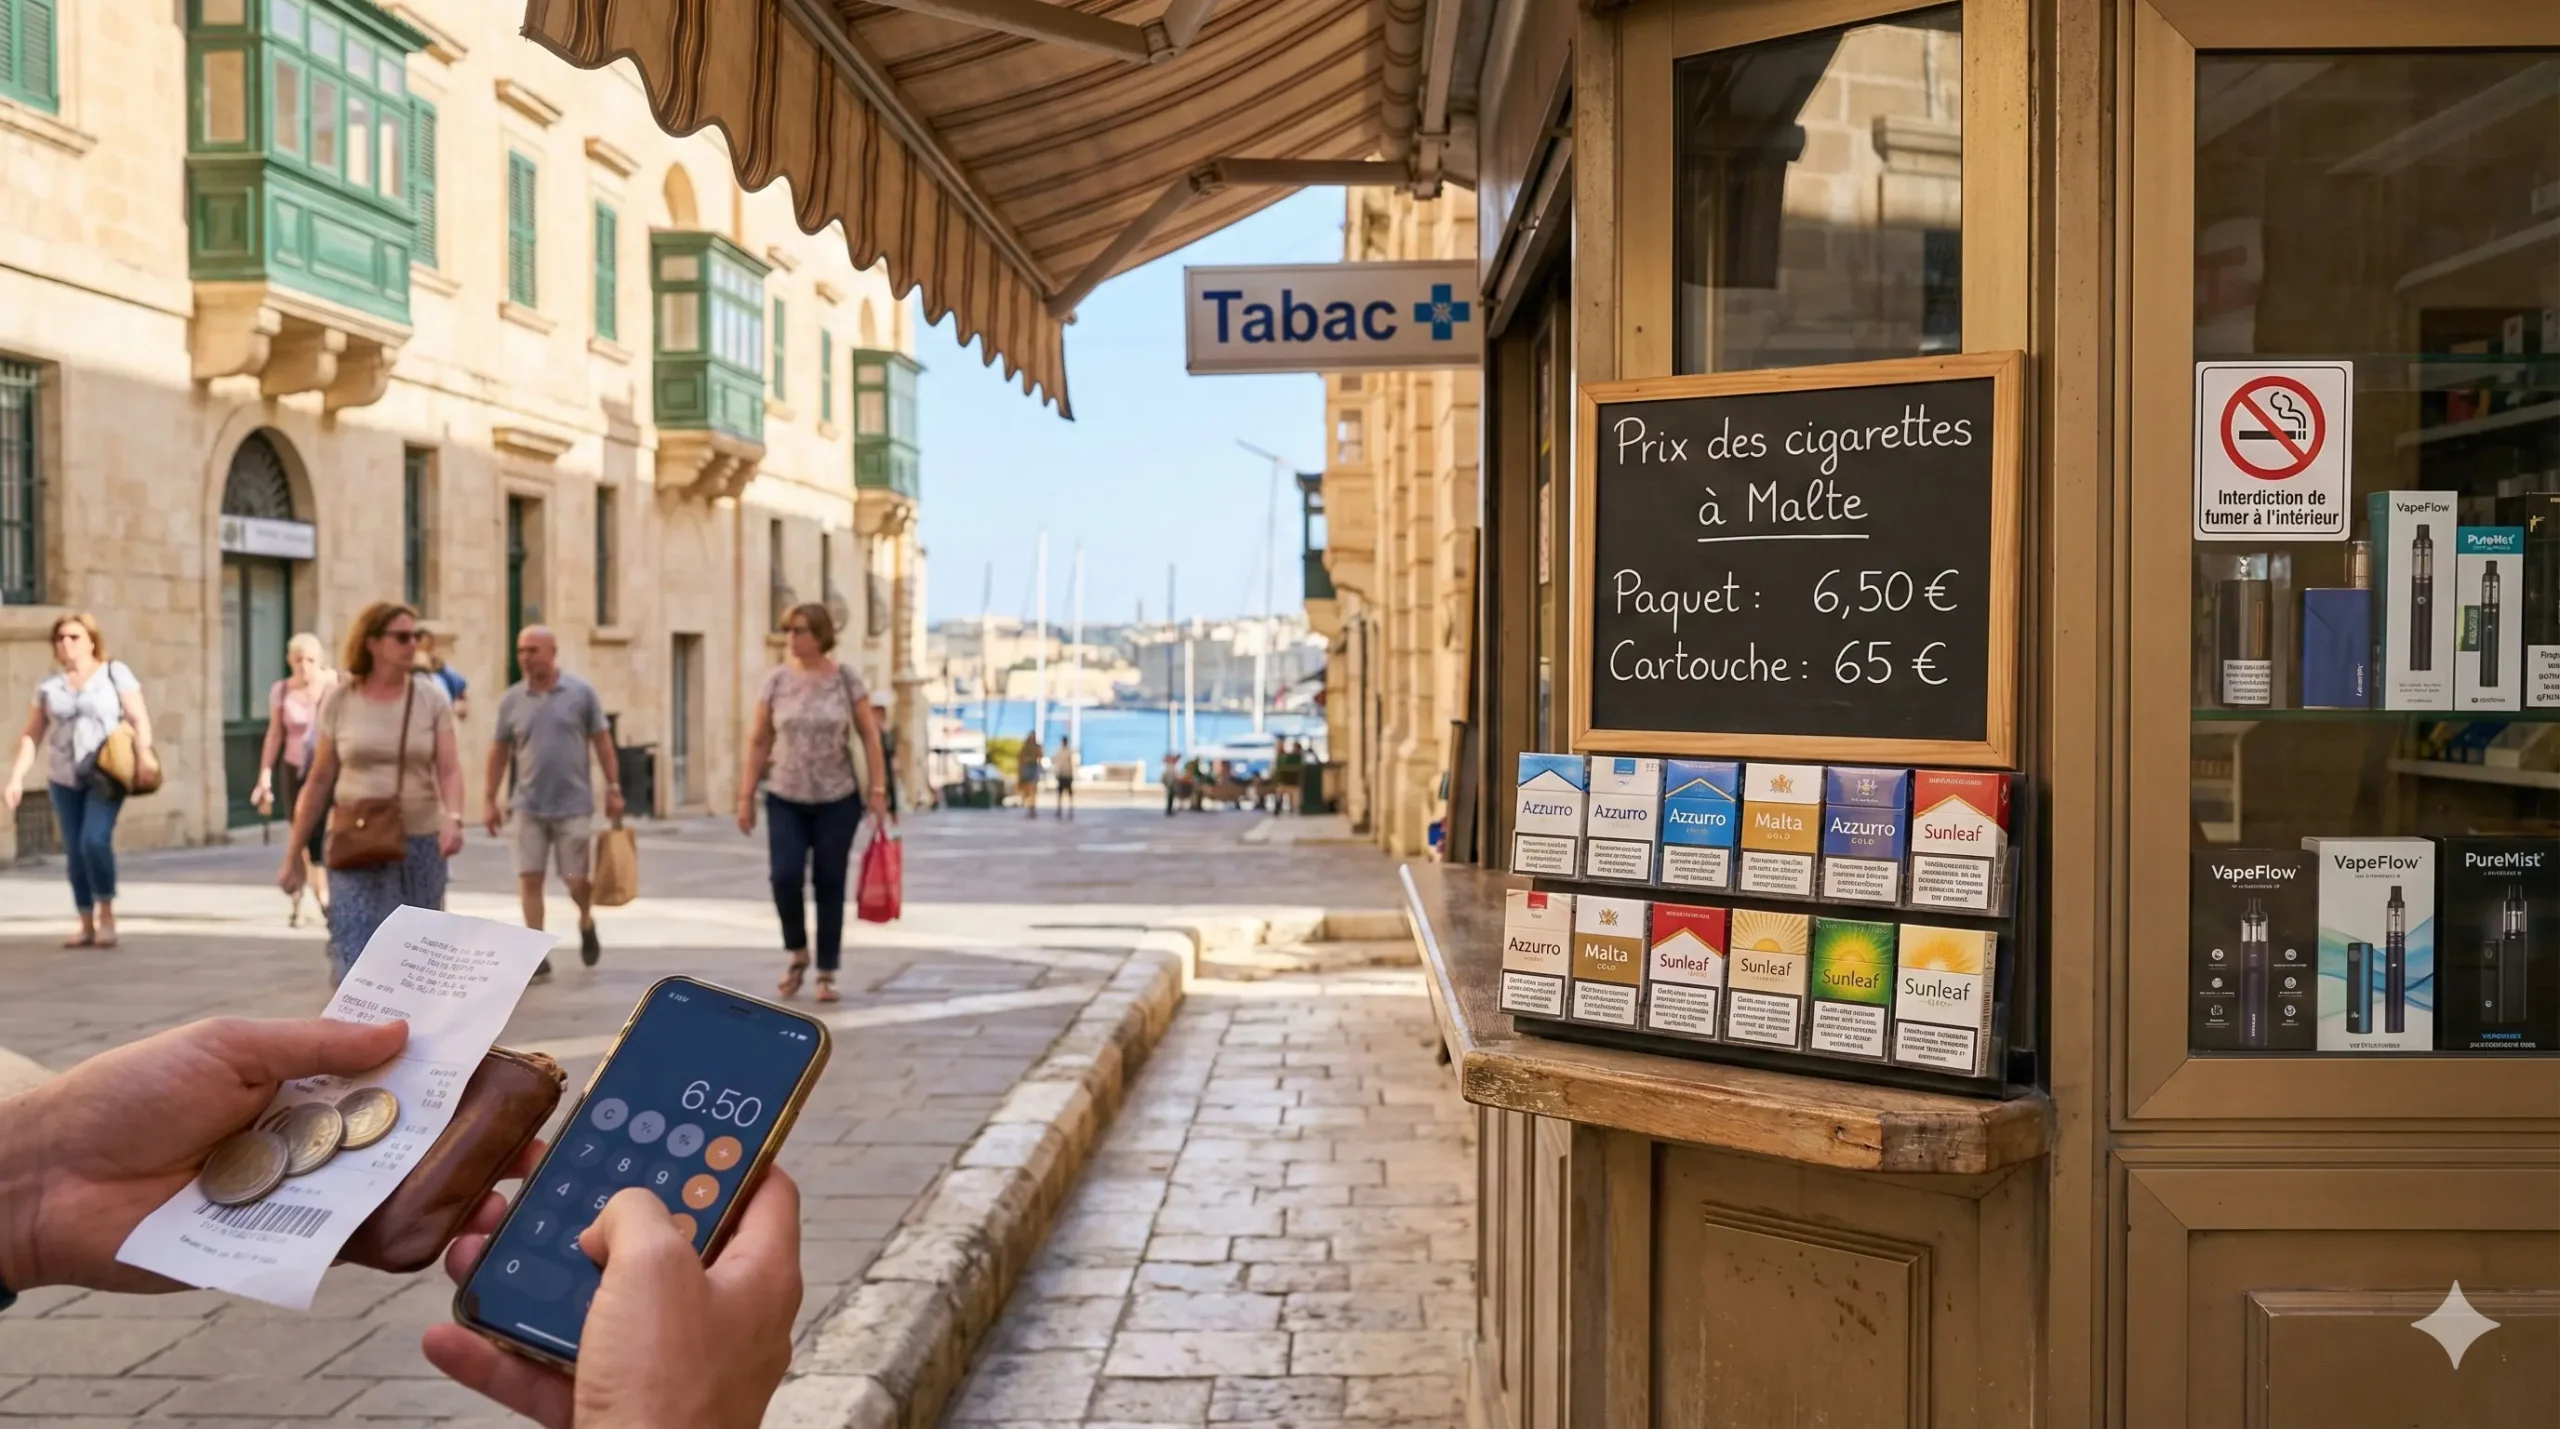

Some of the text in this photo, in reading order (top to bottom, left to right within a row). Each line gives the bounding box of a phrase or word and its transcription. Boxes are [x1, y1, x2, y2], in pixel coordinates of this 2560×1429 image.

[1202, 288, 1397, 343] Tabac
[1613, 404, 1973, 476] Prix des cigarettes
[1698, 479, 1869, 526] à Malte
[2218, 489, 2326, 505] Interdiction de
[2205, 509, 2339, 525] fumer à l'intérieur
[2396, 502, 2450, 515] VapeFlow
[1813, 569, 1914, 620] 6,50
[1924, 569, 1959, 612] €
[1834, 640, 1892, 684] 65
[1911, 641, 1948, 685] €
[1522, 800, 1573, 818] Azzurro
[1594, 804, 1648, 821] Azzurro
[1669, 808, 1727, 827] Azzurro
[1755, 812, 1803, 831] Malta
[1830, 816, 1896, 837] Azzurro
[1924, 823, 1984, 842] Sunleaf
[2334, 855, 2419, 873] VapeFlow
[2465, 852, 2541, 868] PureMist
[2211, 864, 2297, 883] VapeFlow
[1508, 936, 1561, 956] Azzurro
[1585, 943, 1629, 963] Malta
[1660, 953, 1710, 972] Sunleaf
[1740, 958, 1793, 977] Sunleaf
[1822, 968, 1880, 989] Sunleaf
[1904, 977, 1972, 1001] Sunleaf
[681, 1080, 762, 1128] 6.50
[579, 1144, 595, 1158] 7
[617, 1158, 632, 1172] 8
[655, 1171, 669, 1185] 9
[556, 1182, 608, 1209] 4 5
[534, 1221, 545, 1234] 1
[506, 1259, 520, 1274] 0
